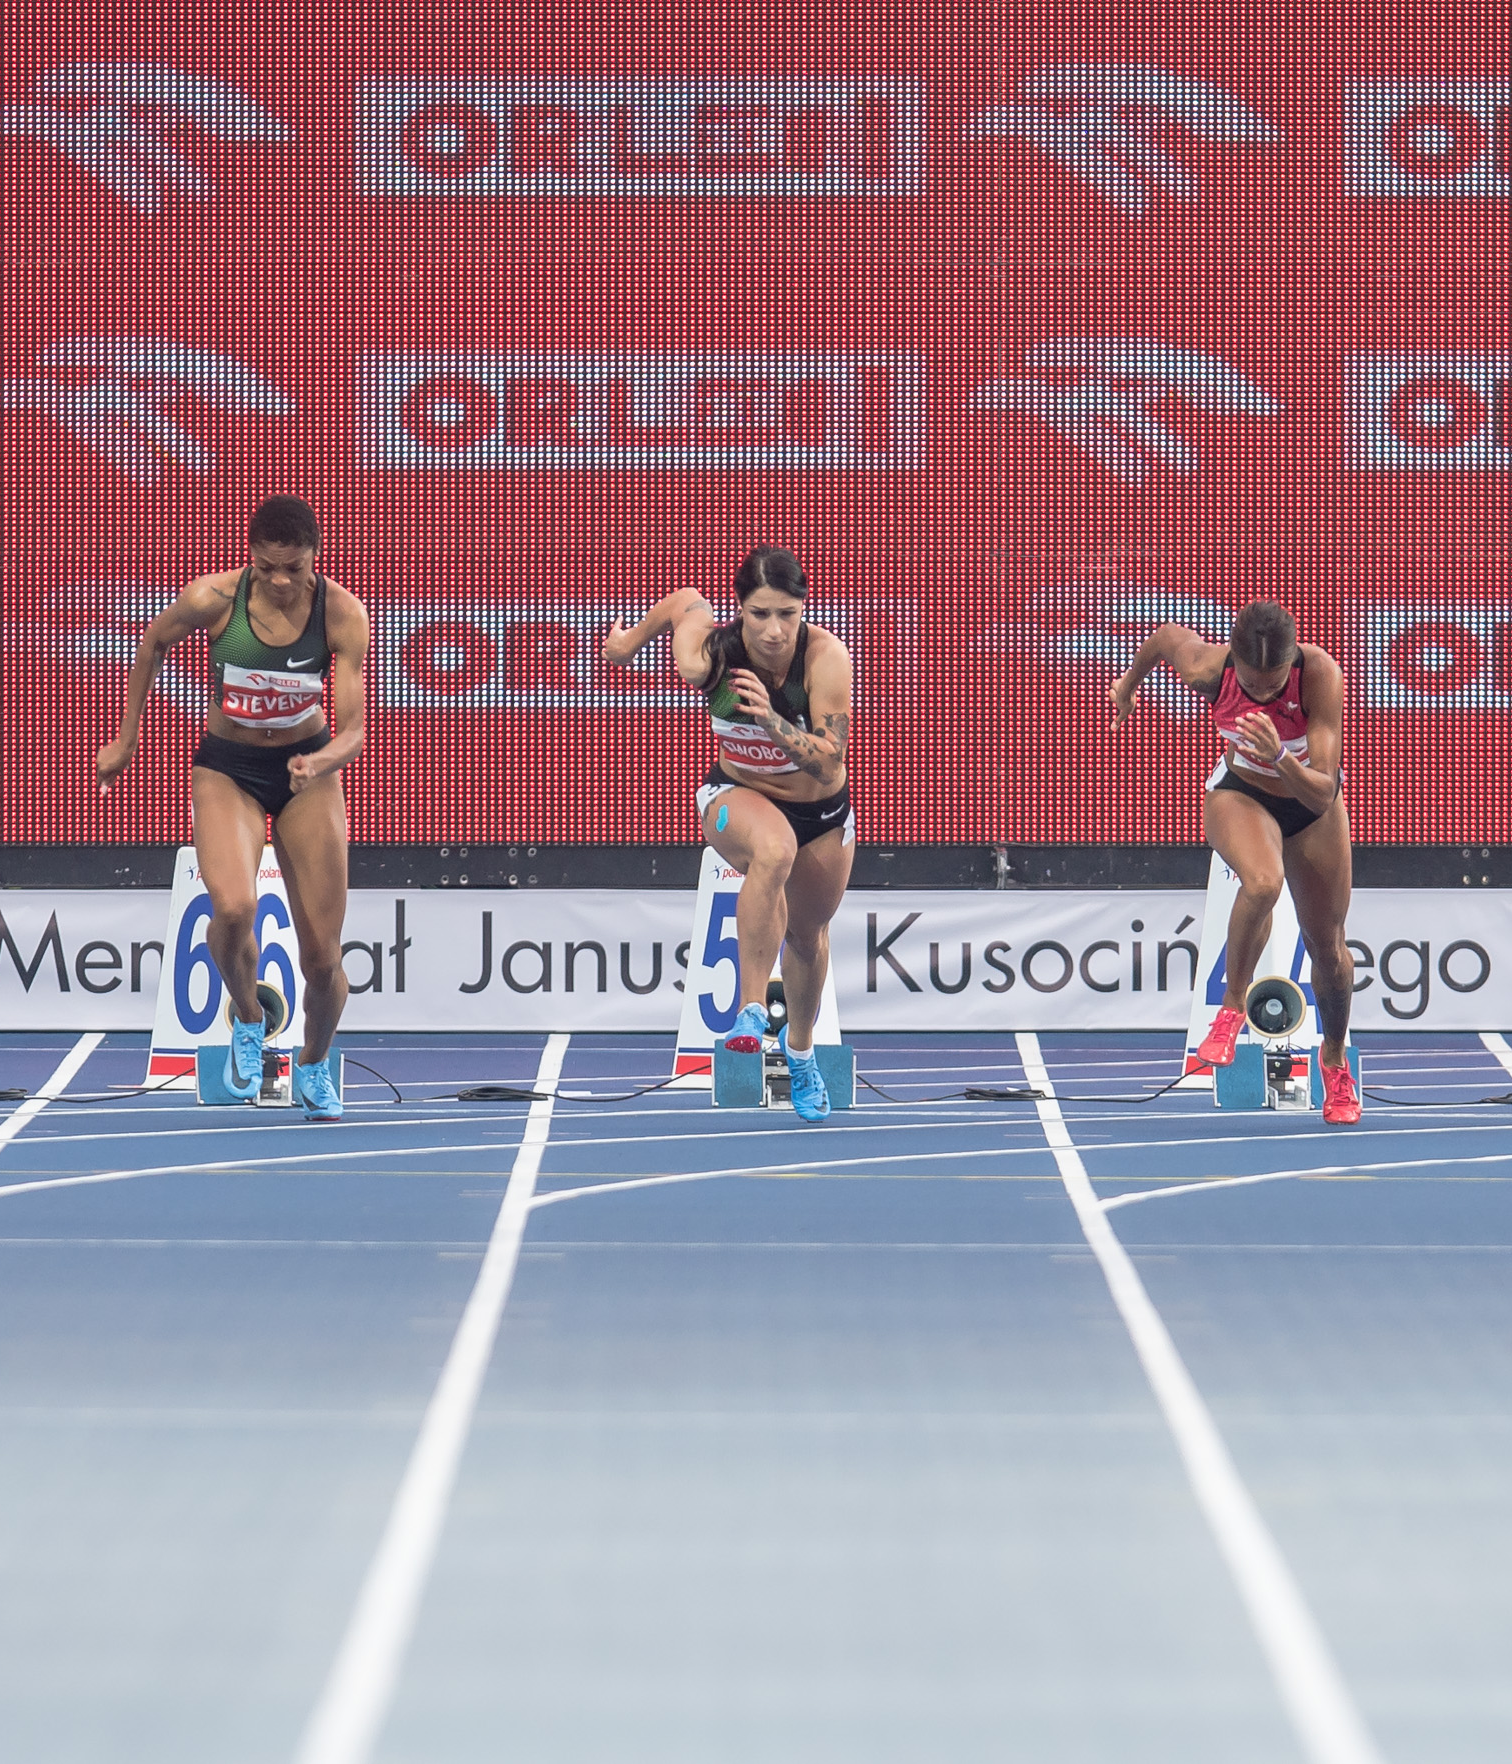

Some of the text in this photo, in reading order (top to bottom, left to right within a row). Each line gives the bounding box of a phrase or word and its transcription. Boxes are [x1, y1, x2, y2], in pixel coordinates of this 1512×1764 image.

[723, 740, 787, 761] SWOBO
[174, 893, 223, 1035] 6
[697, 892, 742, 1034] 5
